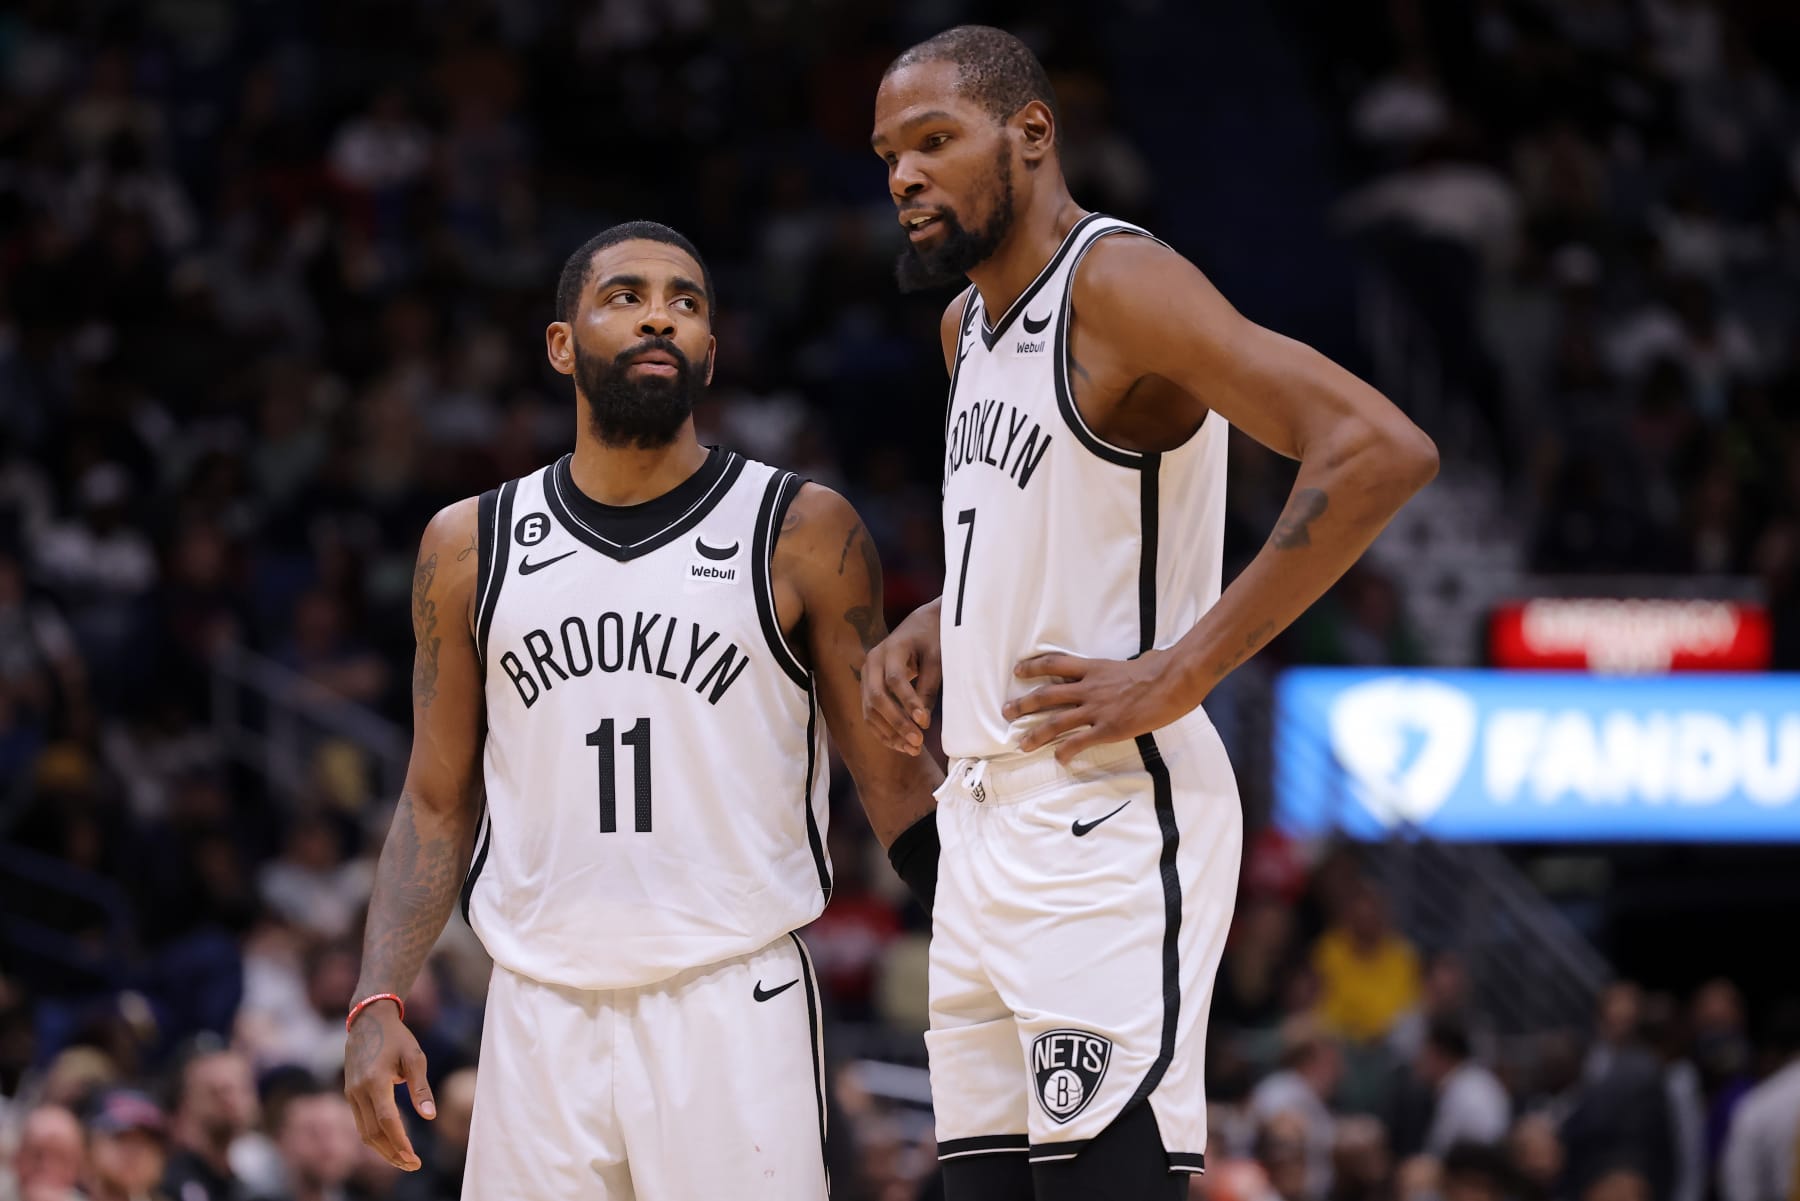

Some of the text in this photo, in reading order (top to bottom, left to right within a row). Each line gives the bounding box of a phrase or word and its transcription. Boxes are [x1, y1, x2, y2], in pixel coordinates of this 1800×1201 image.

[1017, 340, 1046, 354] Webull
[946, 399, 1052, 490] ROOKLYN
[523, 516, 543, 543] 6
[691, 564, 736, 581] Webull
[955, 508, 976, 626] 7
[500, 611, 750, 709] BROOKLYN
[586, 717, 652, 832] 11
[1034, 1035, 1103, 1073] NETS
[1057, 1076, 1068, 1107] B
